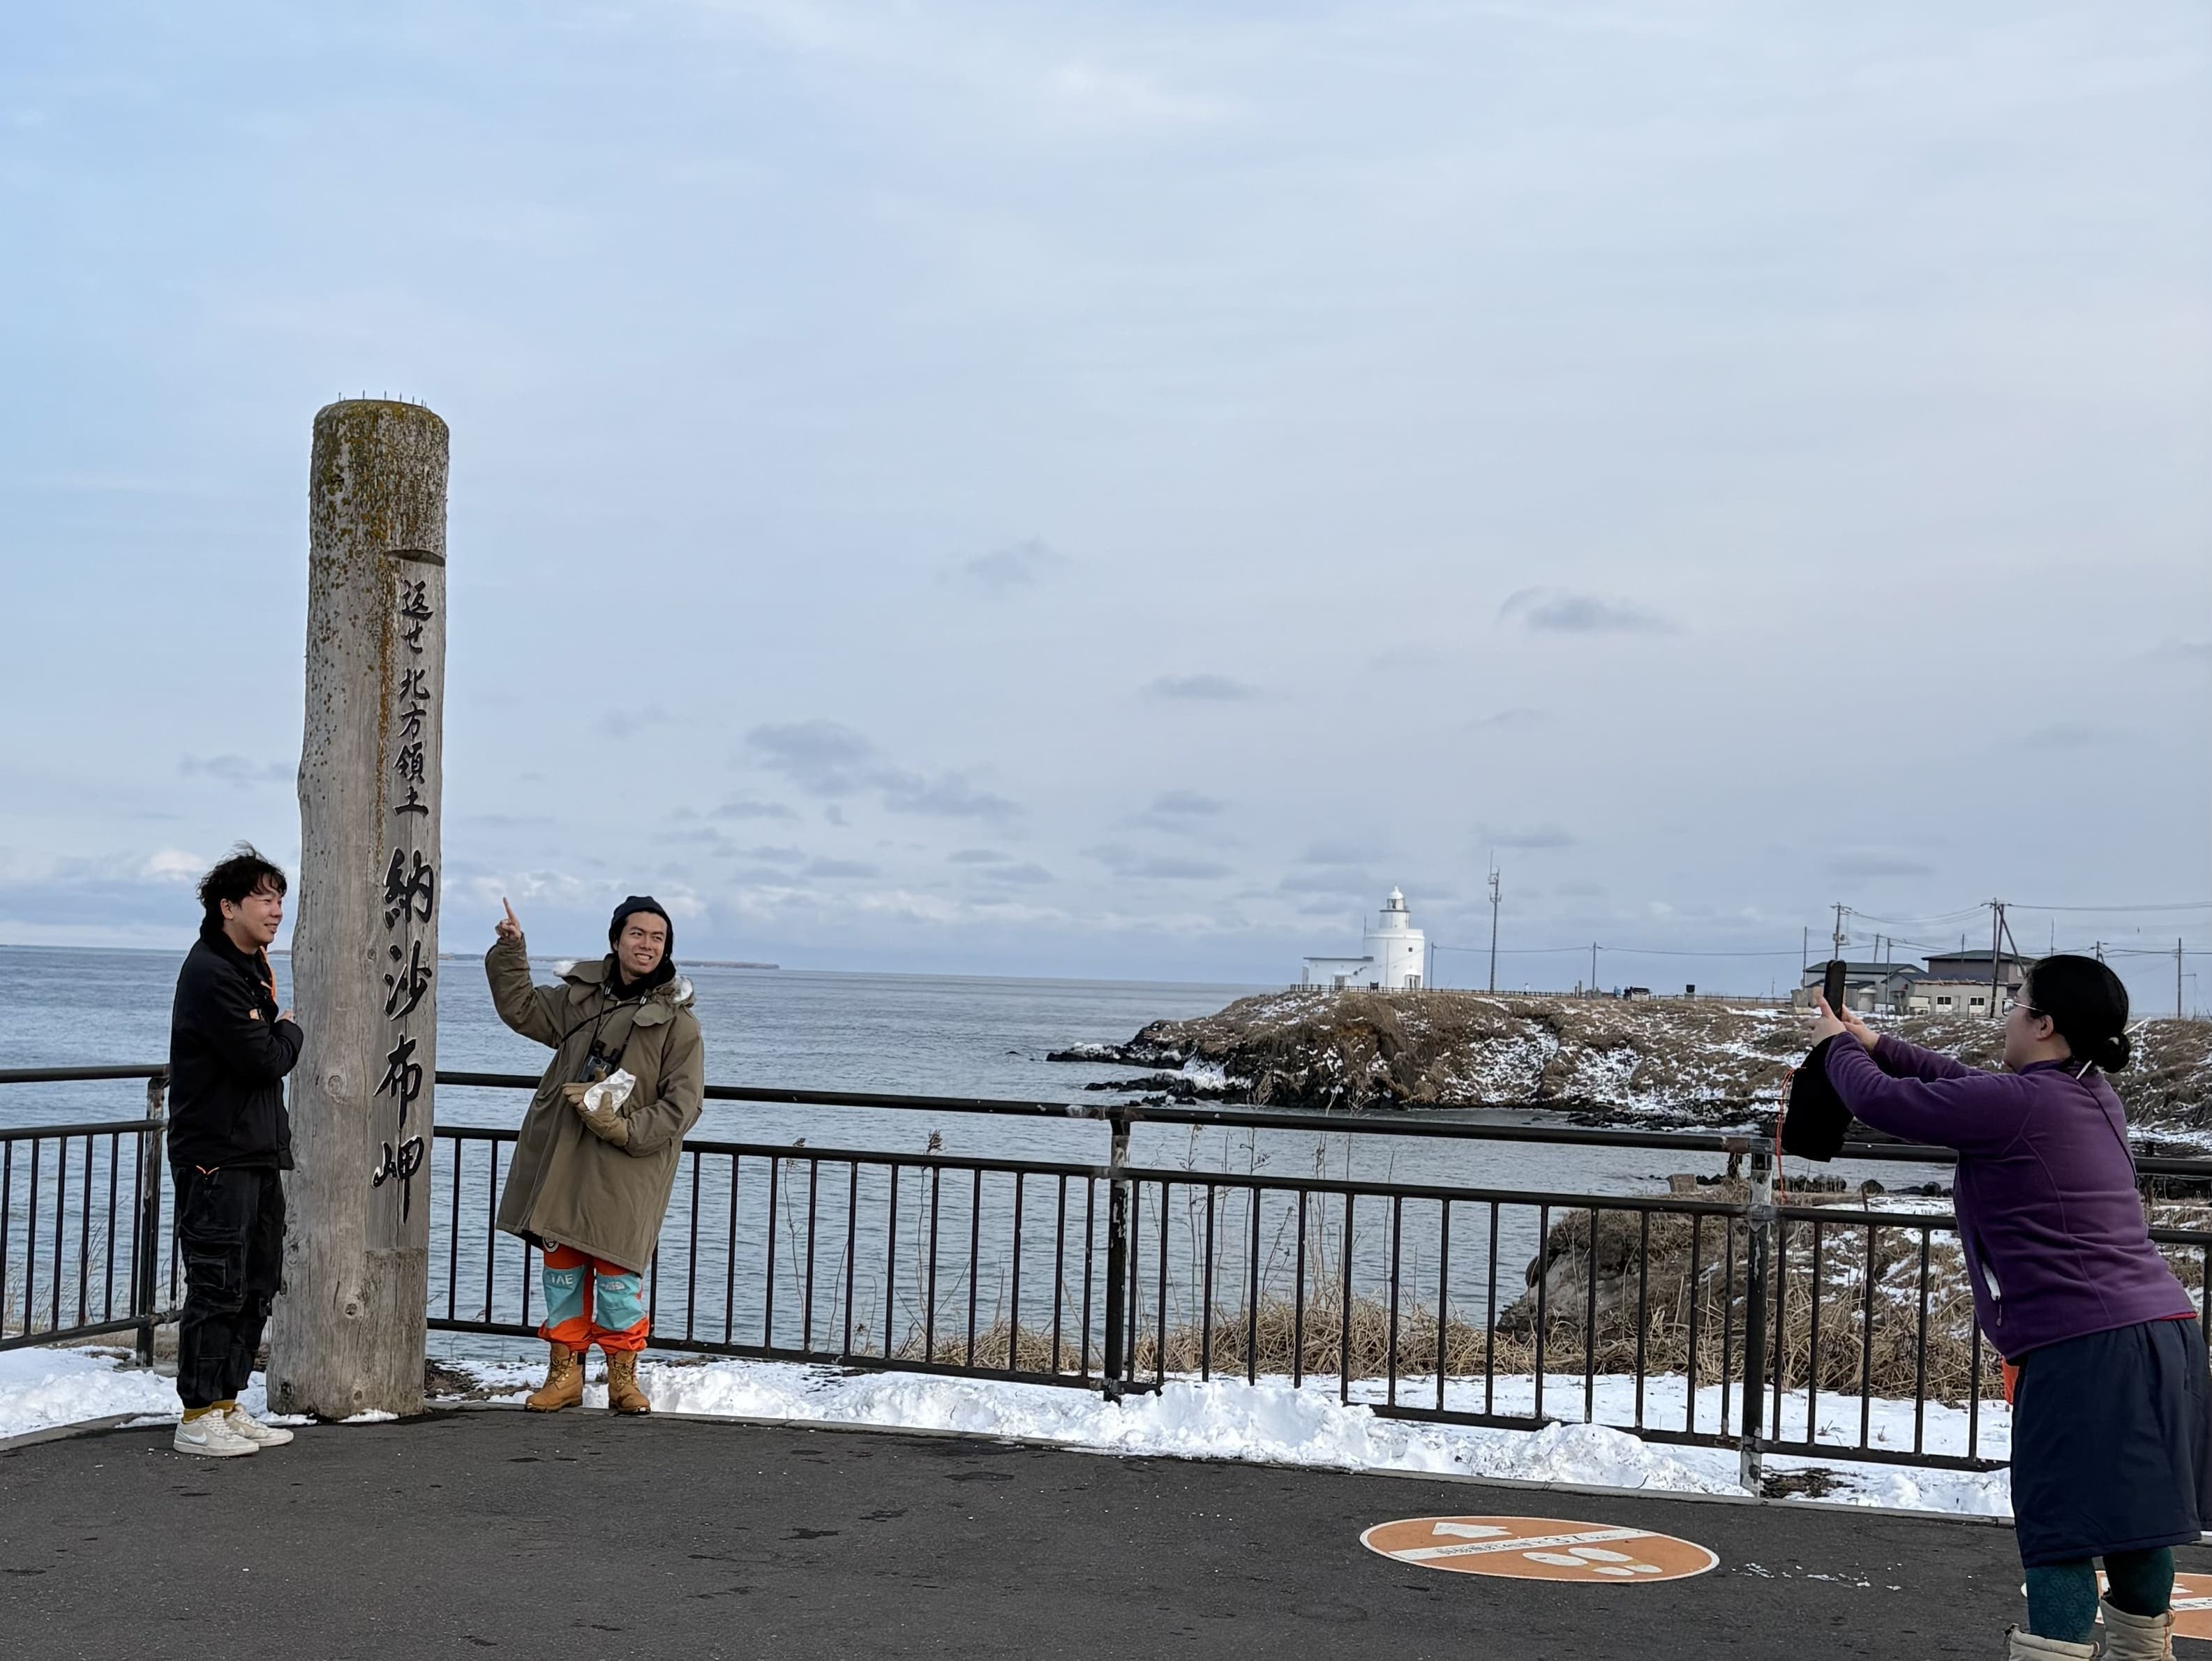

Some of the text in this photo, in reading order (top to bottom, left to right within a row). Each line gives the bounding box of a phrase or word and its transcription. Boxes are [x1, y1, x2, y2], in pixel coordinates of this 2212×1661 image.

[392, 579, 433, 818] 返せ 北方領土
[371, 846, 434, 1225] 納沙布岬
